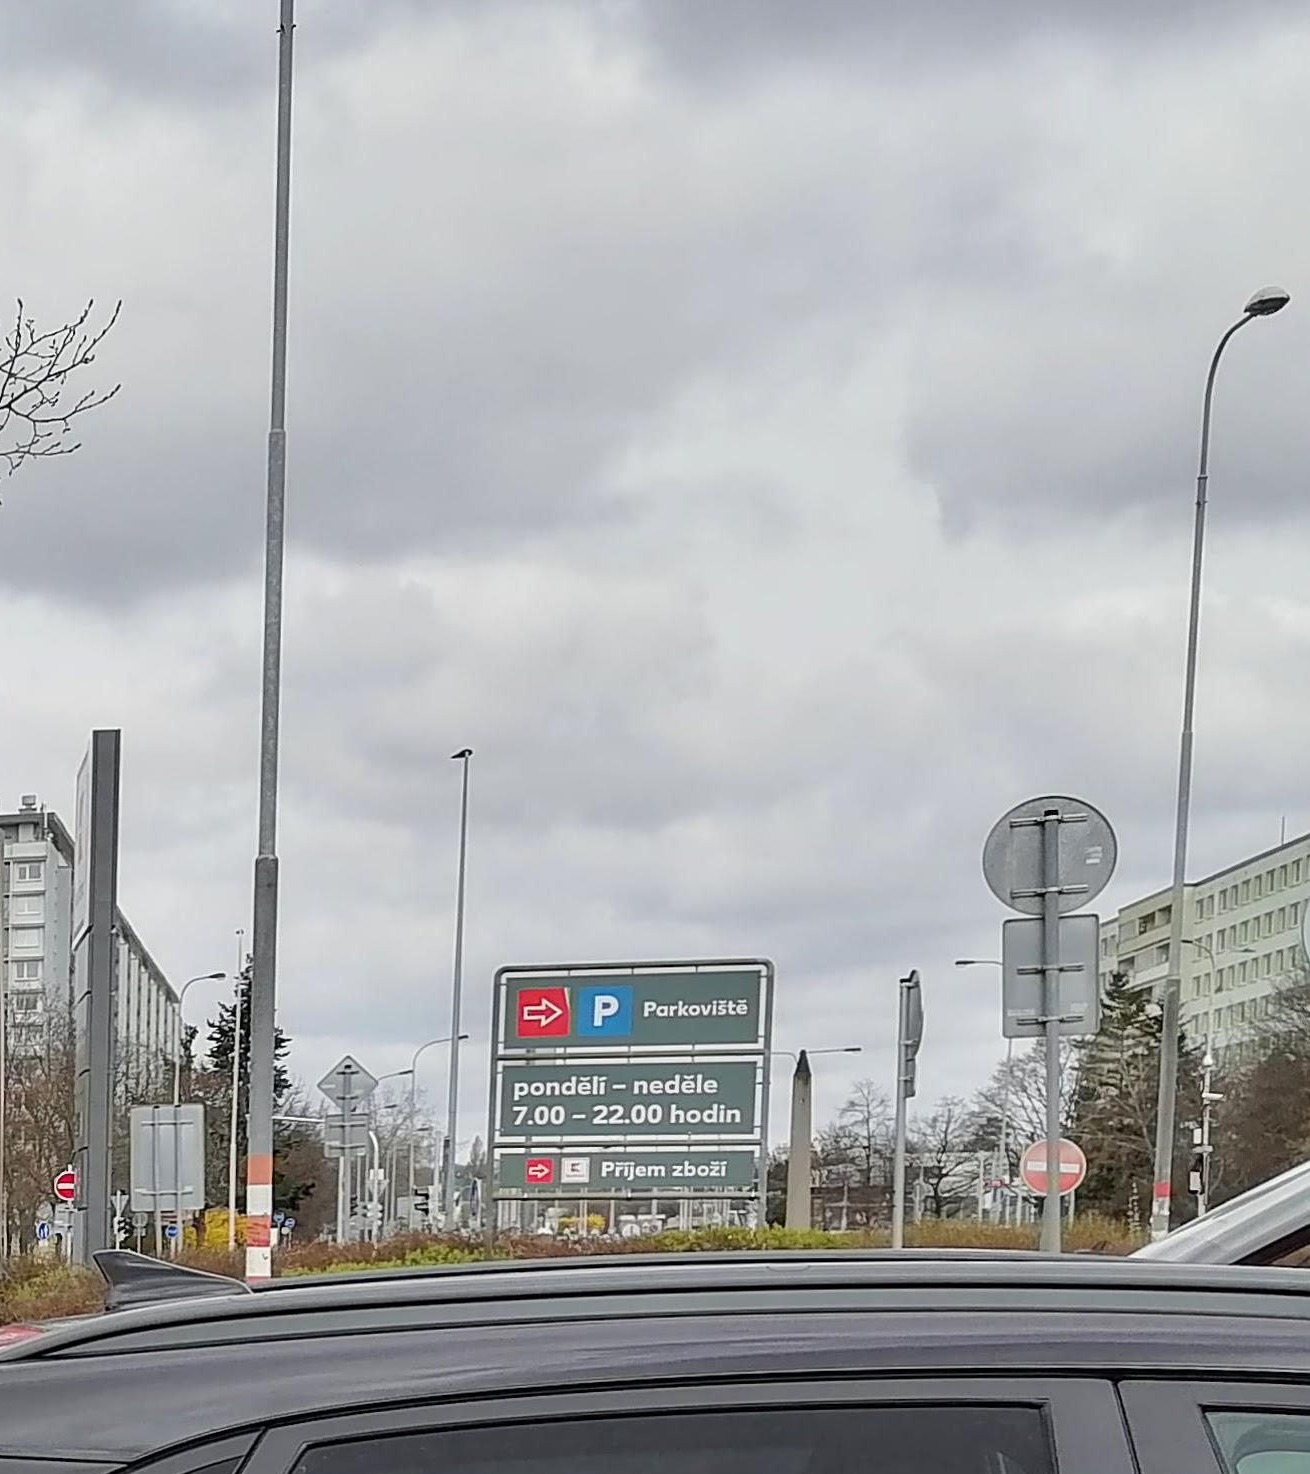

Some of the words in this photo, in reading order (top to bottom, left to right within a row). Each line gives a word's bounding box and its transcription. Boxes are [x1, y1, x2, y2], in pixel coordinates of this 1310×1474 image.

[594, 995, 619, 1027] P
[643, 999, 749, 1018] Parkoviště
[513, 1076, 606, 1100] pondělí
[633, 1075, 718, 1095] neděle
[512, 1106, 565, 1125] 7.00
[592, 1104, 663, 1124] 22.00
[670, 1103, 741, 1124] hodin
[601, 1160, 665, 1180] Příjem
[672, 1160, 727, 1177] zboží
